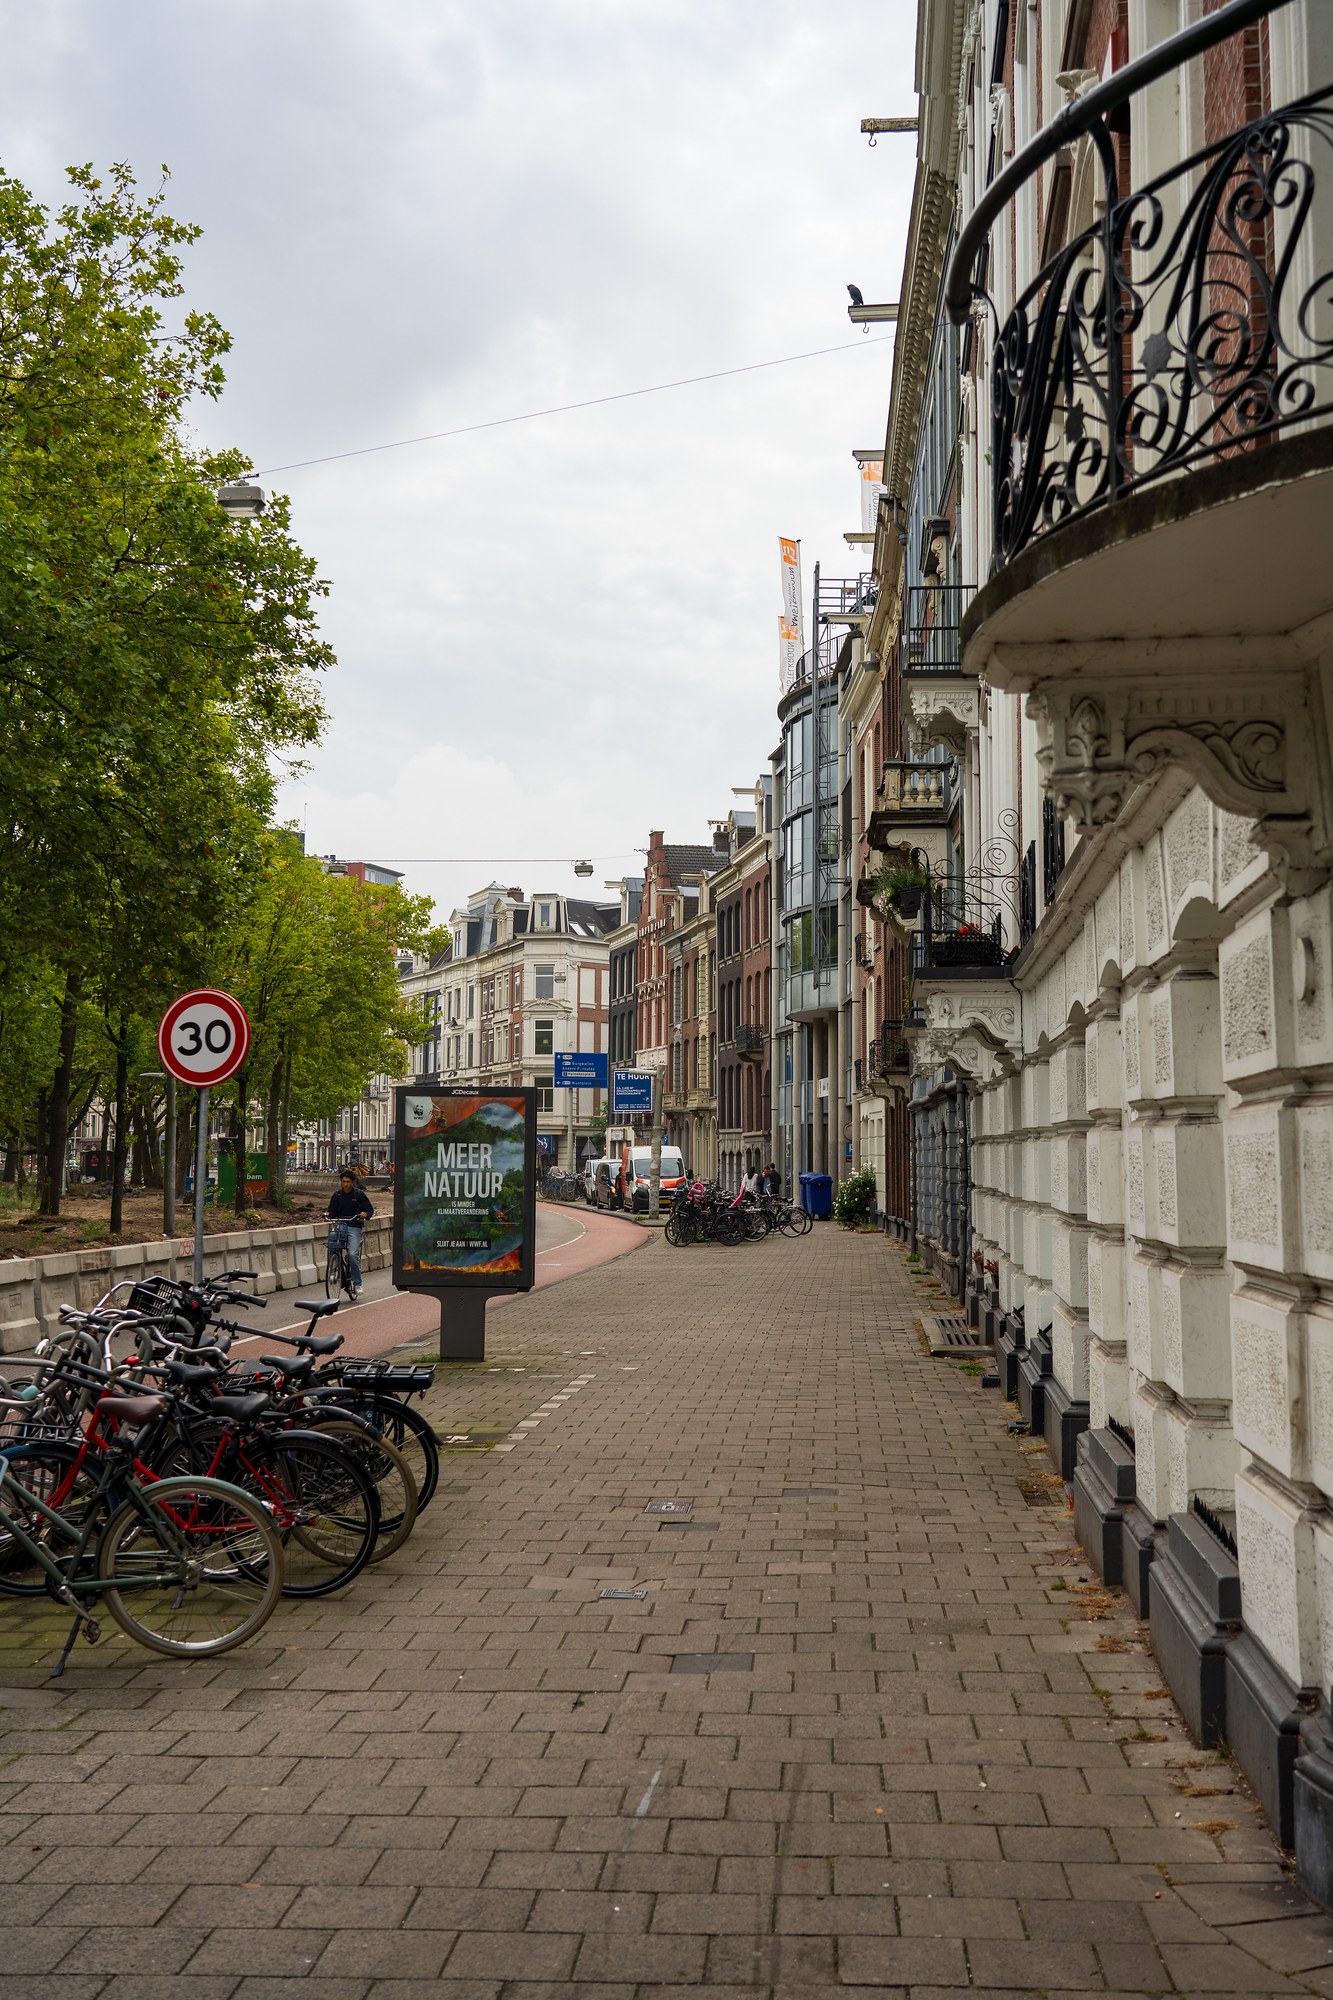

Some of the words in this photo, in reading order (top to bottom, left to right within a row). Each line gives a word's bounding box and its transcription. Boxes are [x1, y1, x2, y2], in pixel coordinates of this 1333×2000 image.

[177, 1019, 231, 1056] 30
[437, 1142, 492, 1169] MEER
[424, 1171, 503, 1198] NATUUR
